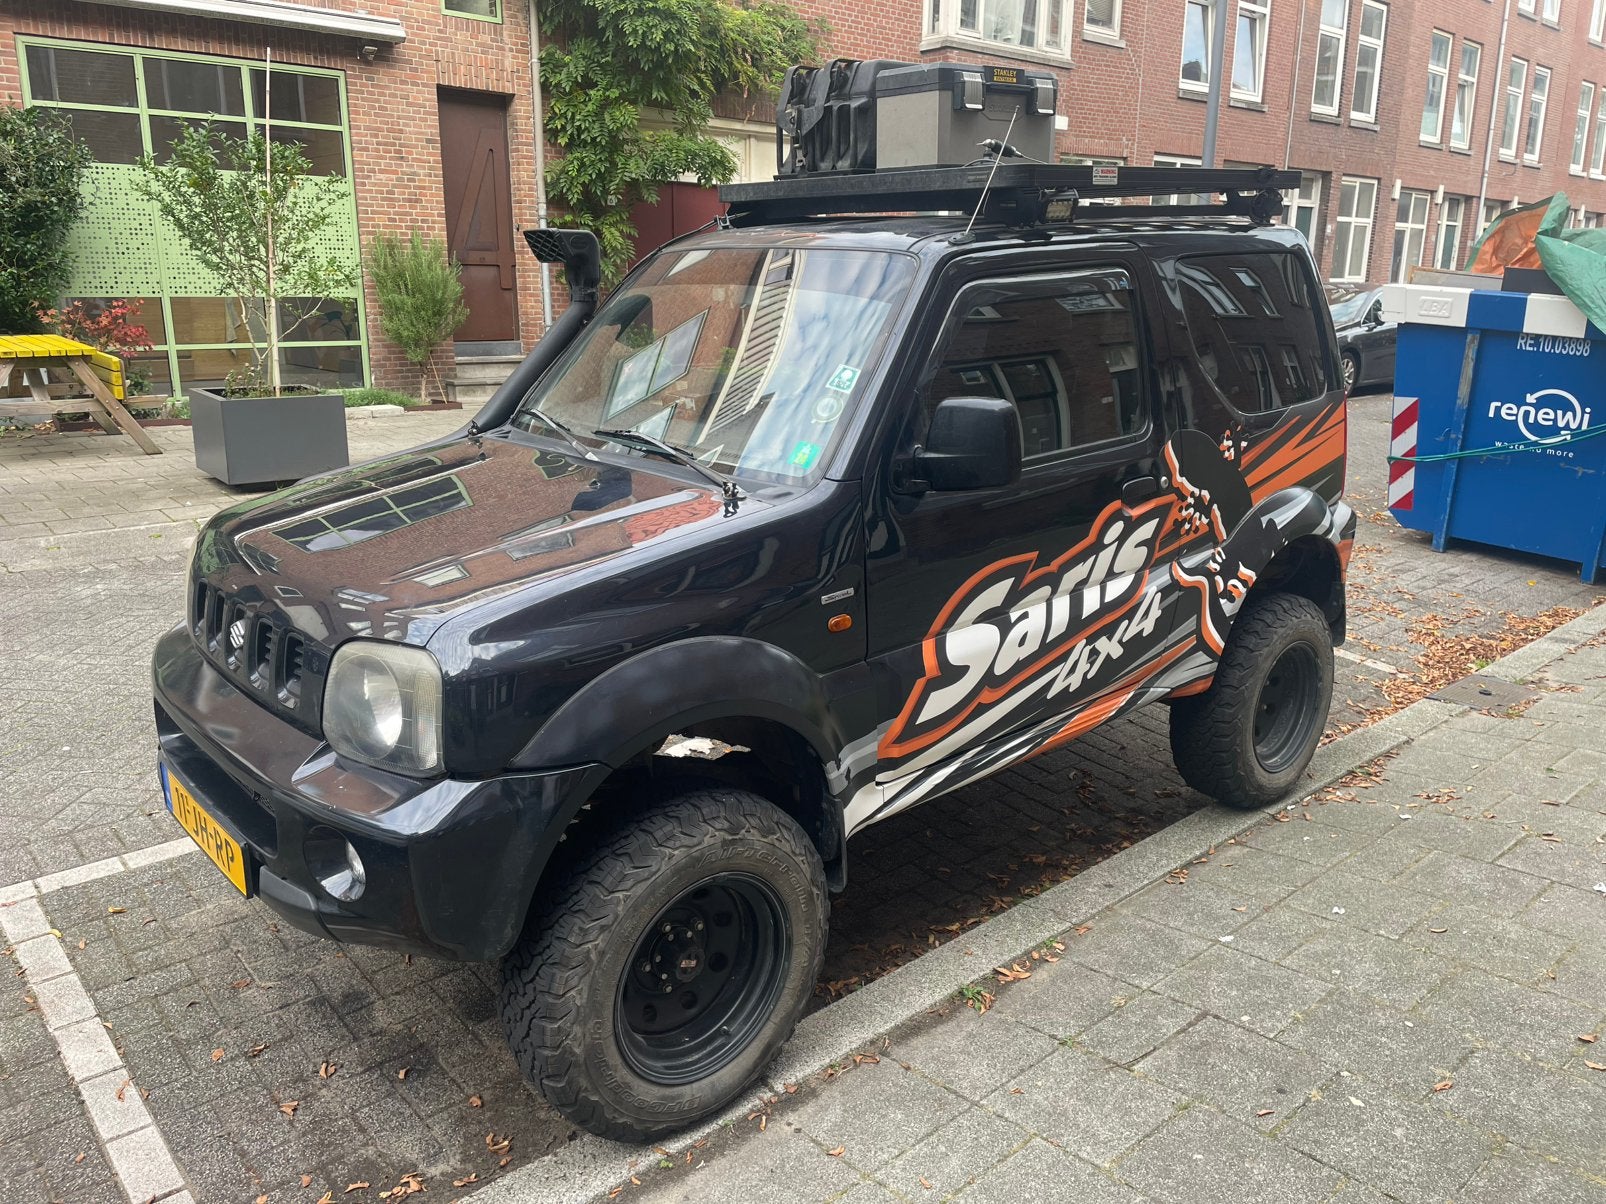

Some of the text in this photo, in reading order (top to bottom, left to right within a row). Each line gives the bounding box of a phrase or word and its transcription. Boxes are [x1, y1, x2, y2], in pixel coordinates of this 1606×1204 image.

[993, 68, 1017, 77] STANLEY
[1516, 333, 1591, 357] RE.10.03898
[1488, 398, 1592, 434] renewi
[1546, 448, 1574, 458] more
[915, 518, 1160, 725] Saris
[1046, 585, 1162, 700] 4x4
[175, 786, 235, 873] 11-JH-RP
